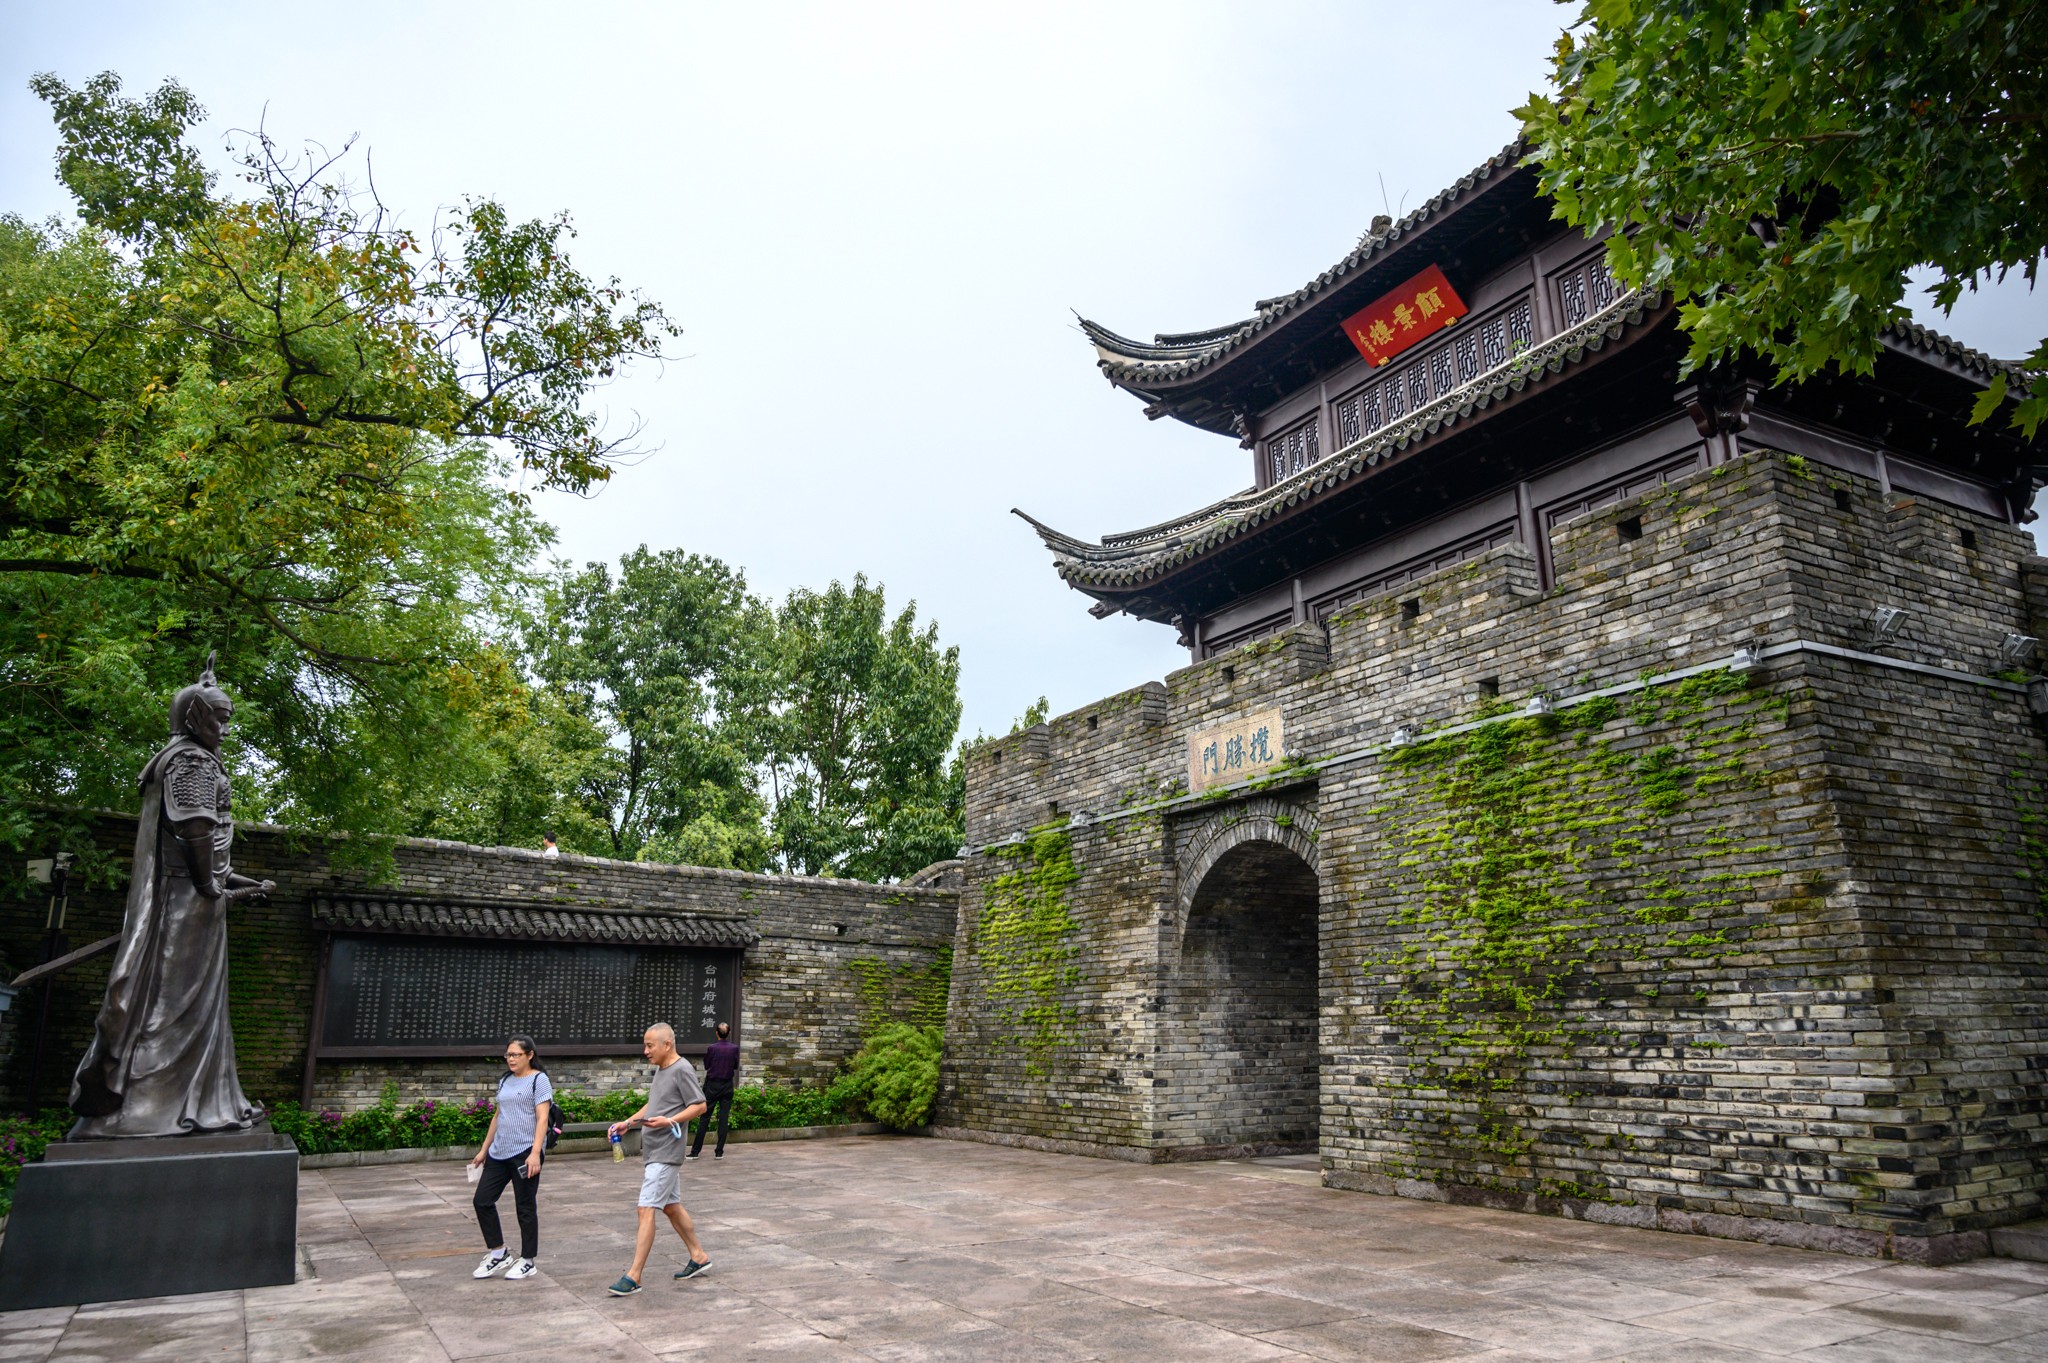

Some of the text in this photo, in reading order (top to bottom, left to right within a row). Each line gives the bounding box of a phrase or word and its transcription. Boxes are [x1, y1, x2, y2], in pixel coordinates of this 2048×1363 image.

[701, 964, 717, 1028] 台州府城墙
